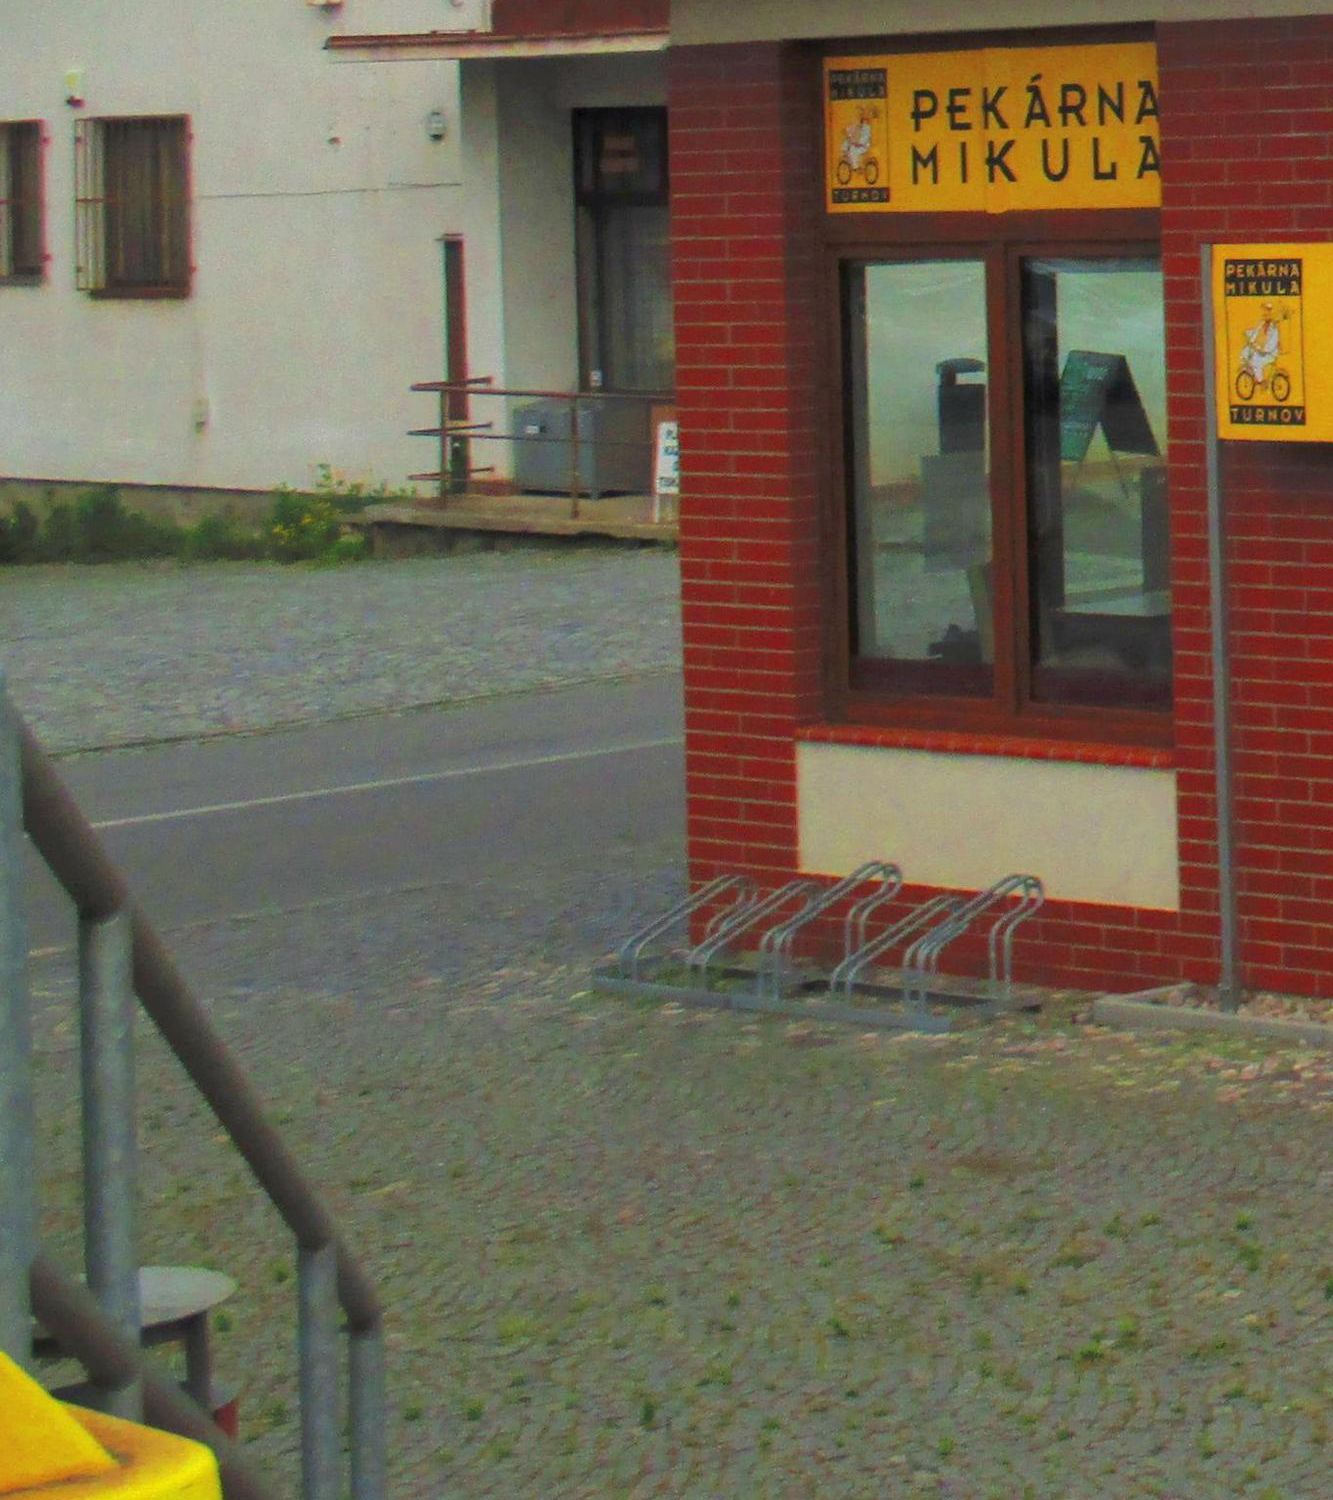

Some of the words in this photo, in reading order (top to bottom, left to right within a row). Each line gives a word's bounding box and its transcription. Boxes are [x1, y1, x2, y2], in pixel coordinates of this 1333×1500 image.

[911, 73, 1160, 132] PEKÁRNA
[911, 136, 1162, 185] MIKULA
[1226, 262, 1299, 277] PEKÁRNA
[1226, 280, 1299, 294] MIKULA
[1231, 408, 1305, 422] TURNOV
